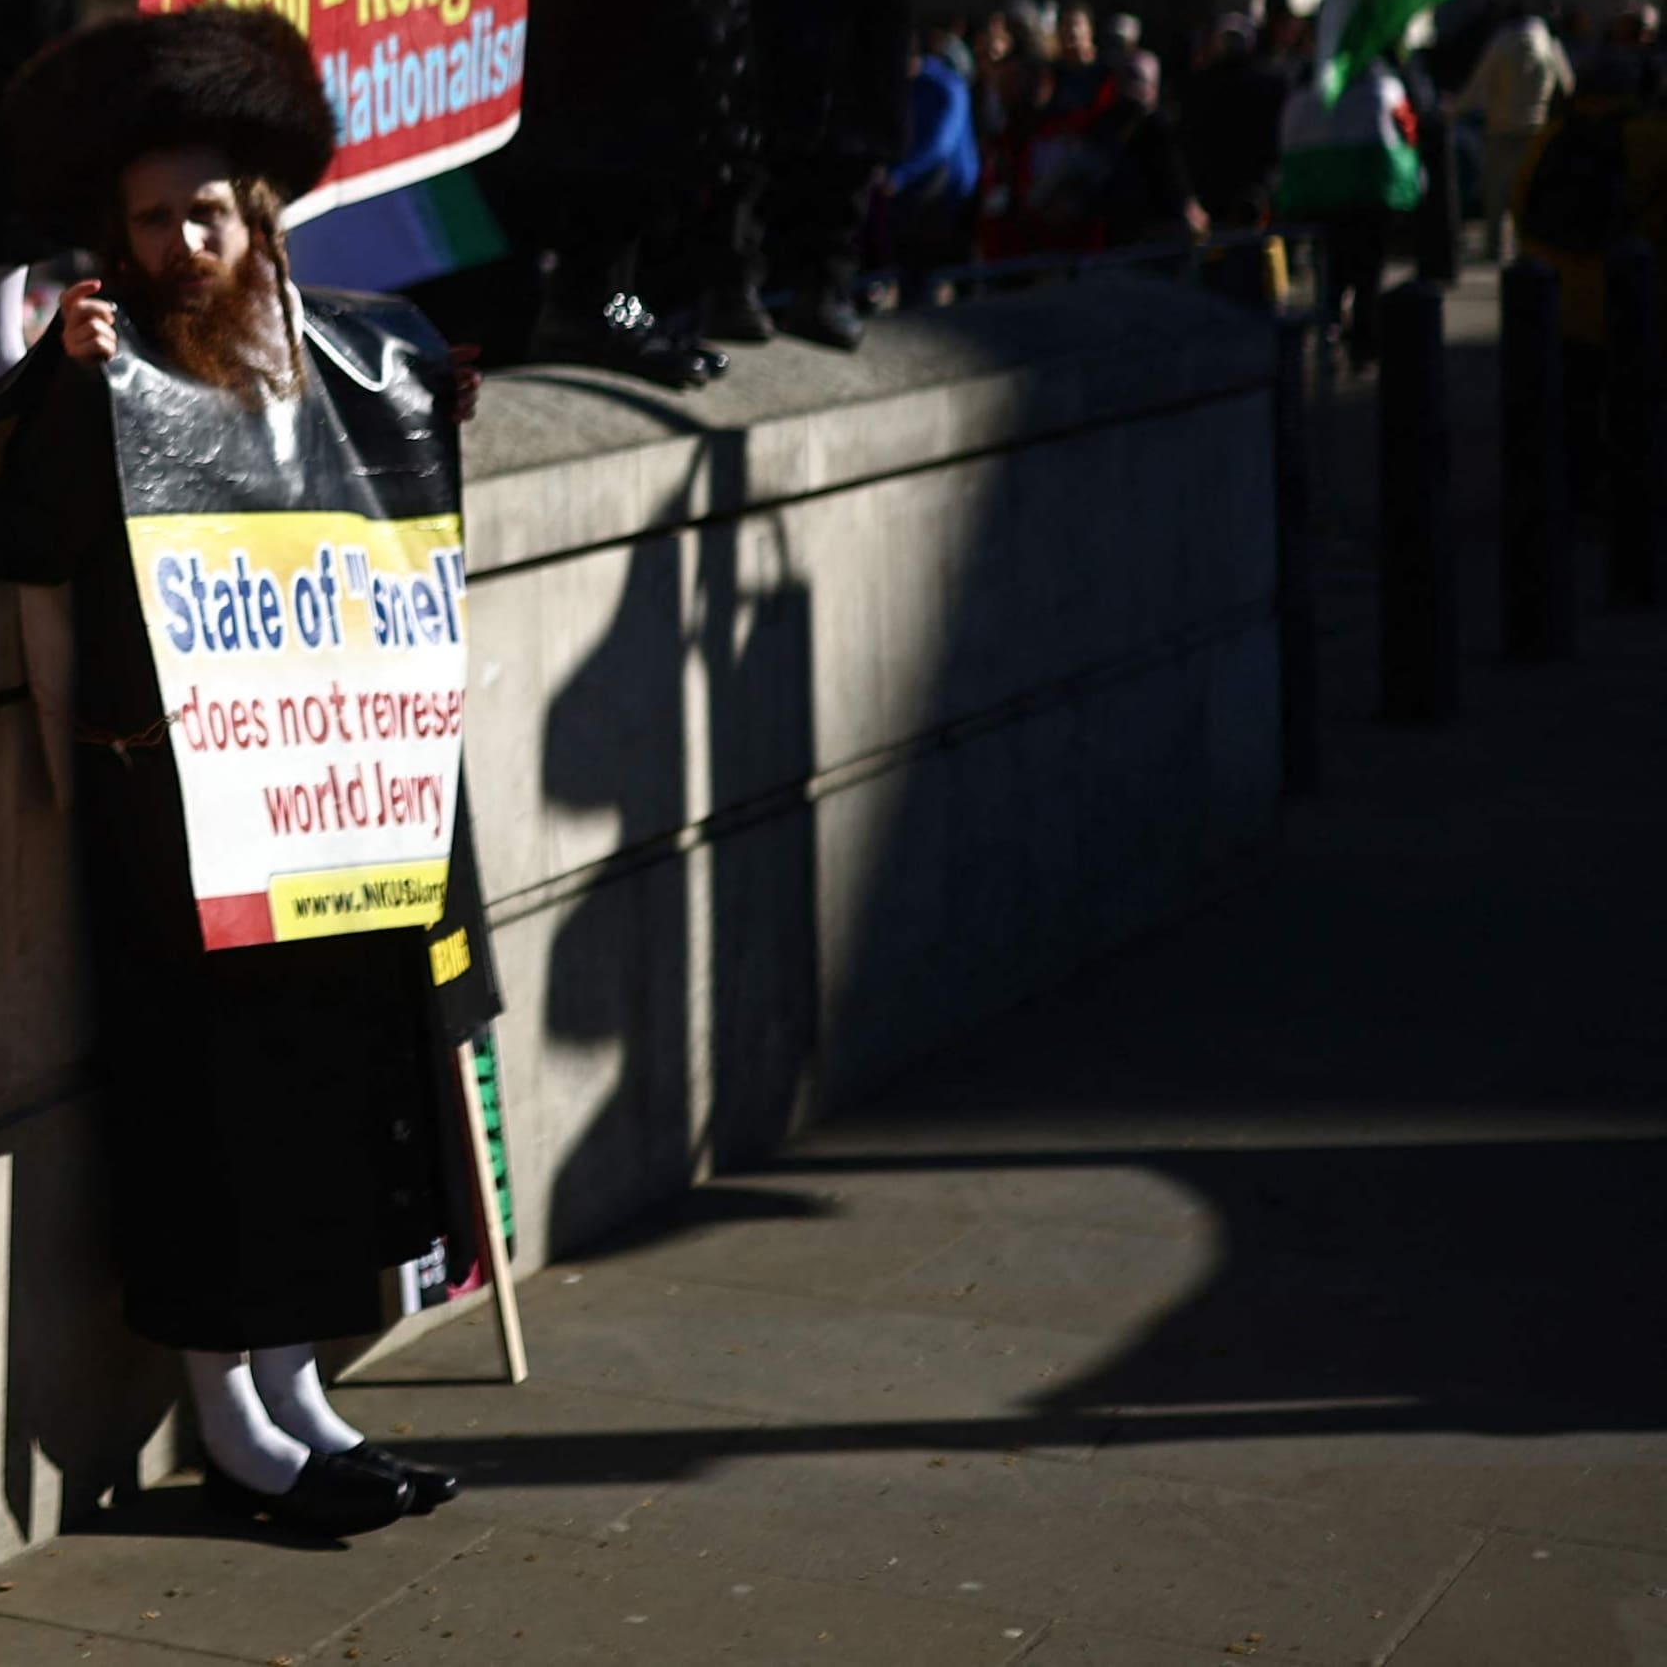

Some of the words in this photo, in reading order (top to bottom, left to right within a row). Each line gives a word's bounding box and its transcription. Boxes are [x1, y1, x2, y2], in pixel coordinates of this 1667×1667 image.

[157, 555, 282, 653] State
[295, 548, 340, 648] of
[180, 684, 267, 753] does
[278, 679, 353, 745] not
[262, 761, 369, 837] world
